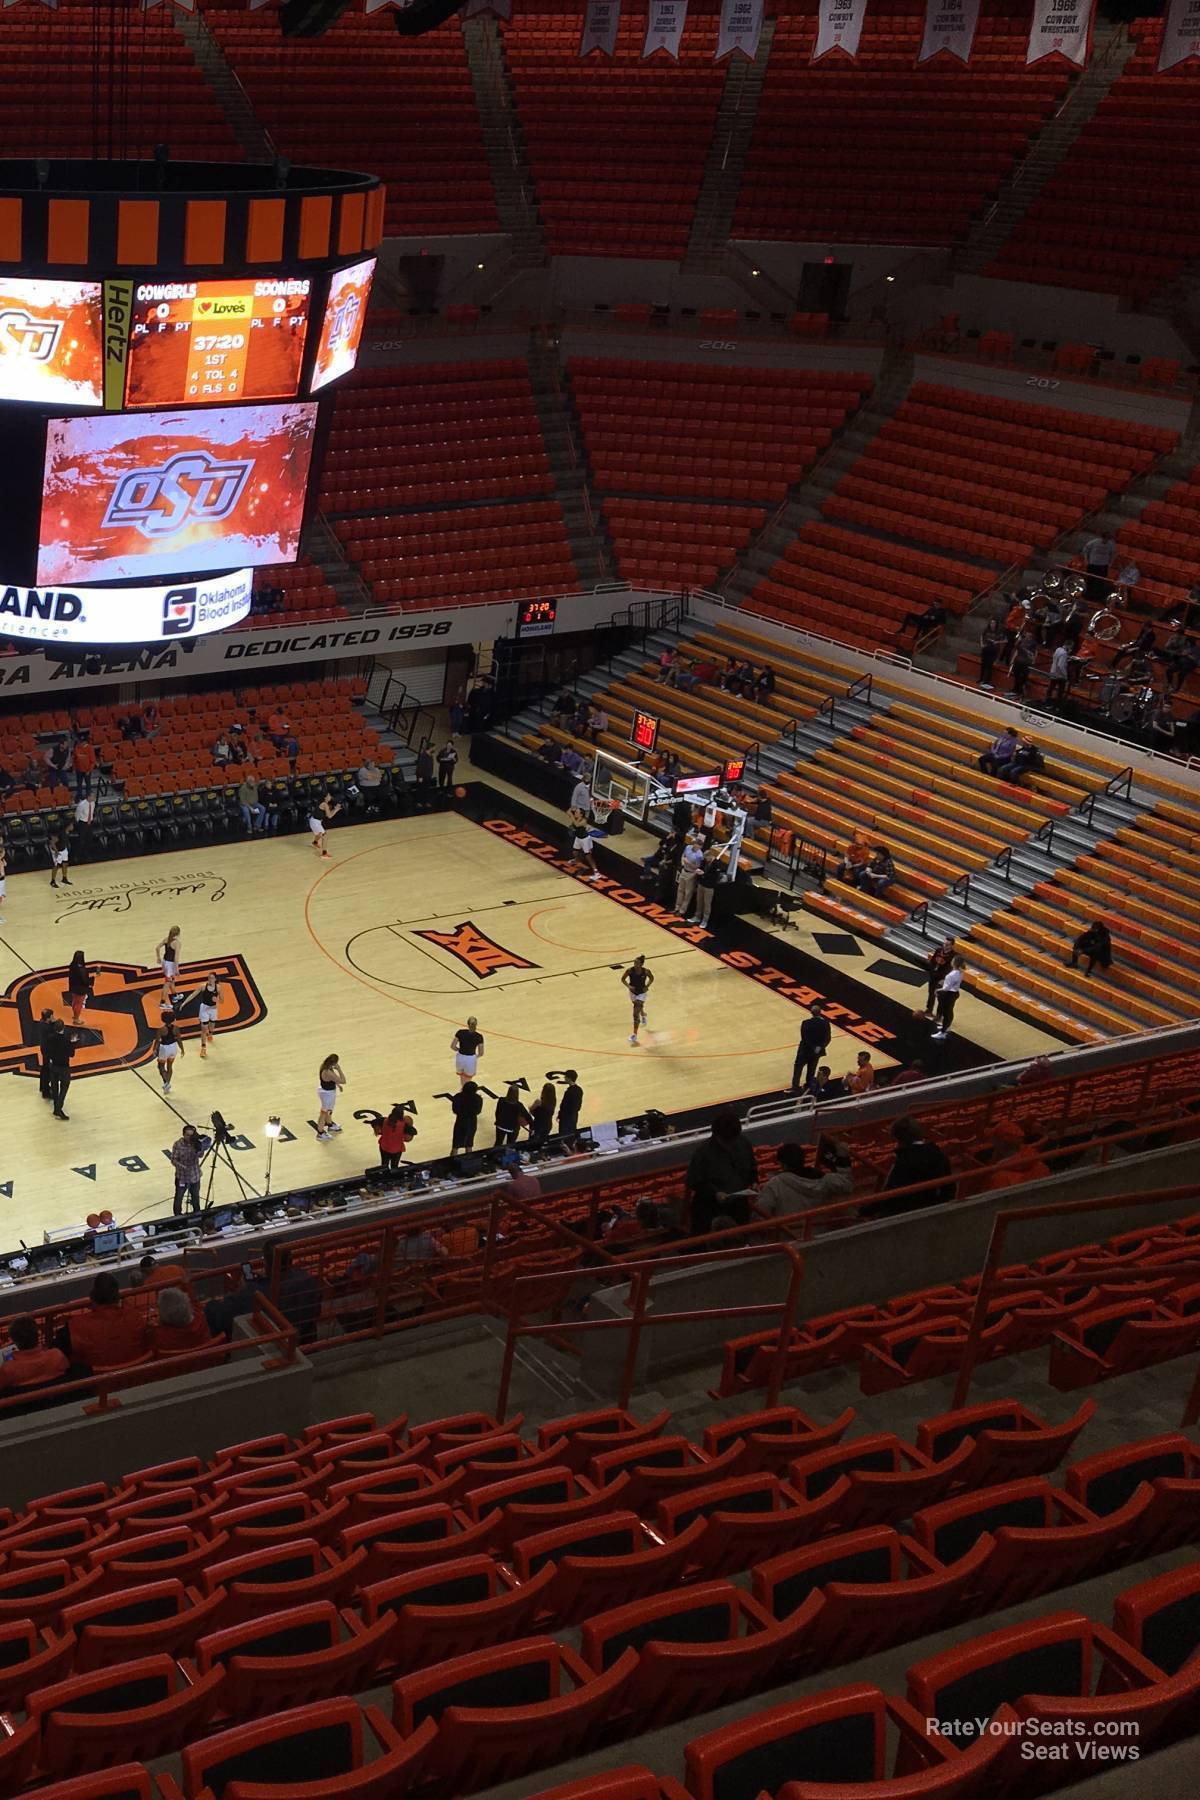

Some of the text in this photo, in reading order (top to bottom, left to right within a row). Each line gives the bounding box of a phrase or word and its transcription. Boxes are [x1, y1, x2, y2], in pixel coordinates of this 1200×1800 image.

[1045, 15, 1079, 25] COWBOY
[1040, 25, 1080, 34] WRESTLING
[137, 280, 310, 300] COWGIRLS SOONERS
[156, 298, 286, 319] 0 0
[107, 285, 129, 363] Hertz
[134, 321, 191, 334] PL F PT
[251, 315, 305, 328] PL F PT
[193, 334, 244, 351] 37:20
[698, 340, 737, 351] 206
[205, 354, 227, 366] 1ST
[191, 370, 199, 381] 4
[229, 368, 238, 379] 4
[1025, 376, 1060, 390] 207
[189, 382, 237, 394] 0 FLS 0
[101, 450, 256, 538] OSU
[198, 584, 246, 607] Oklahoma
[198, 604, 229, 622] Blood
[224, 627, 380, 660] DEDICATED
[387, 620, 453, 641] 1938
[54, 871, 215, 900] EDDIE SUTTON COURT
[482, 818, 897, 1043] OKLAHOMA STATE
